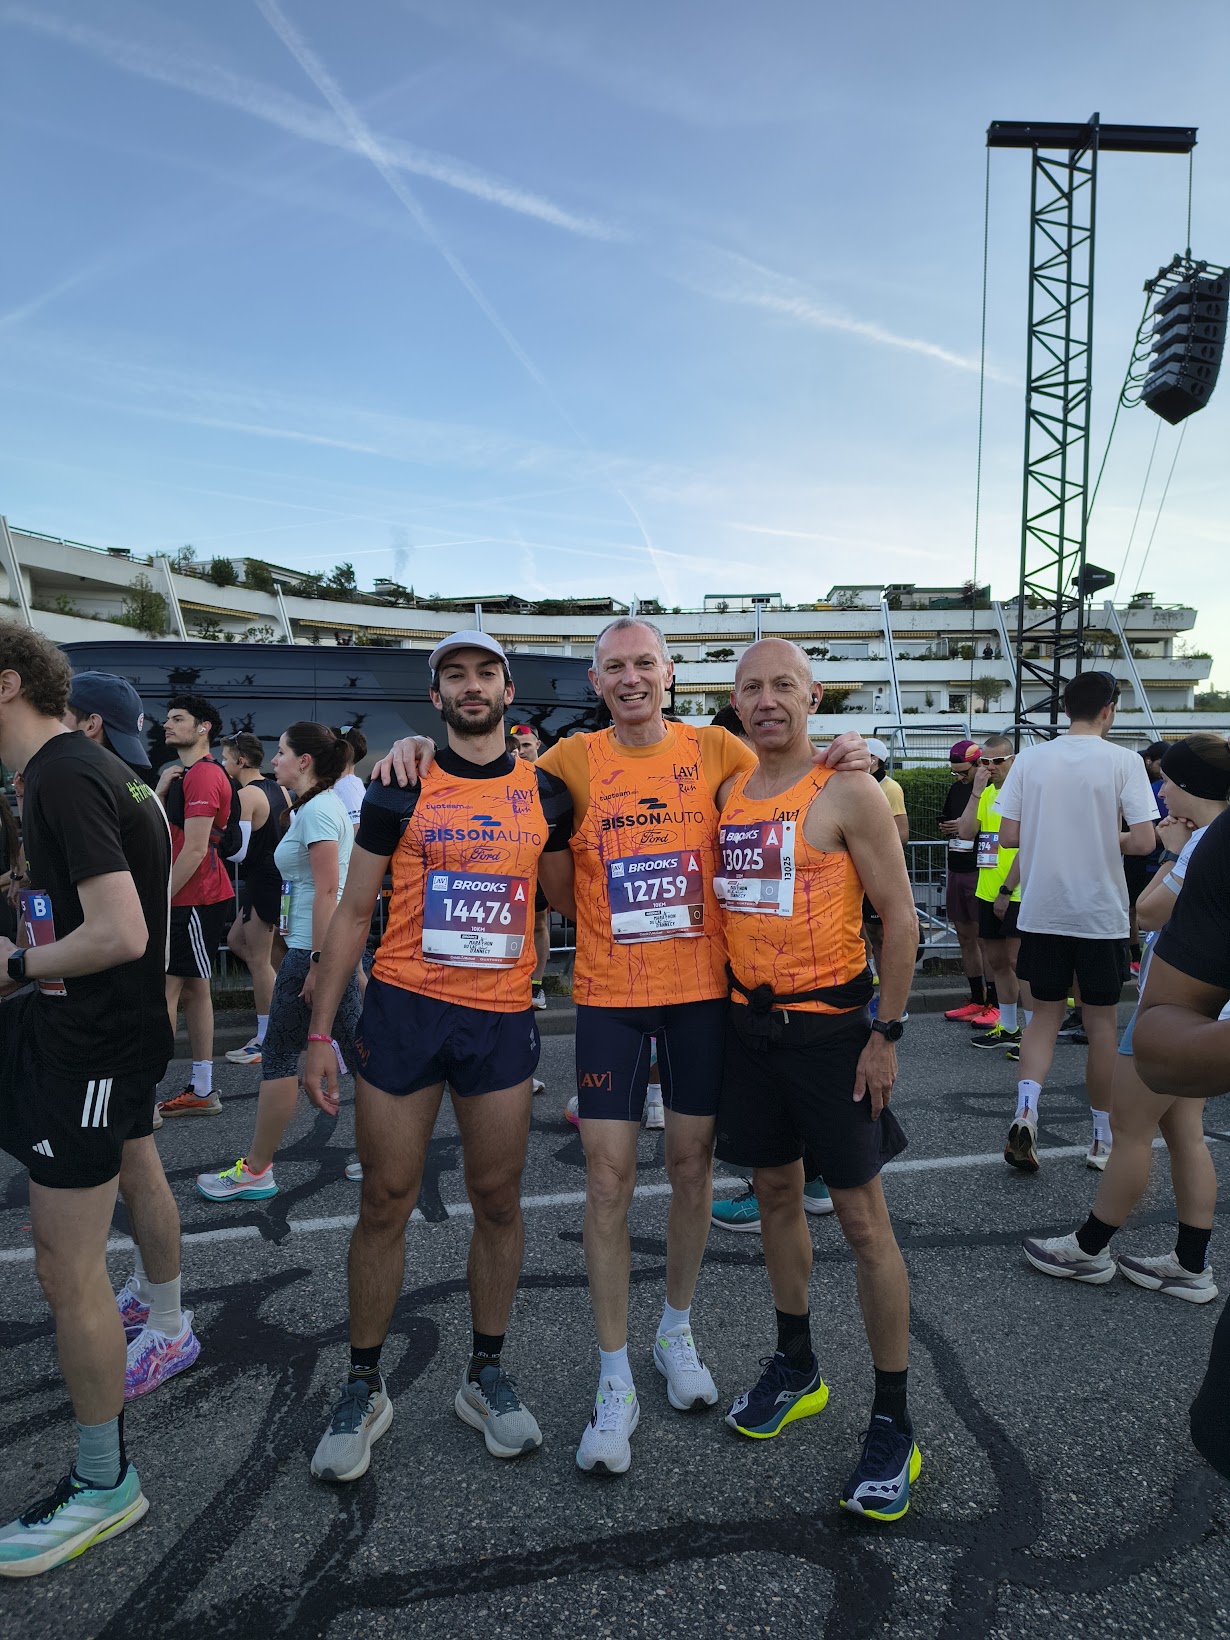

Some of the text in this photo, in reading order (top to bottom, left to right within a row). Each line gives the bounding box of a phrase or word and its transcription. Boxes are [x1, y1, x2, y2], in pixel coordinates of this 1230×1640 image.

[640, 831, 669, 844] Ford
[765, 827, 779, 846] A
[470, 846, 502, 861] Ford
[687, 854, 699, 872] A
[628, 858, 678, 874] BROOKS
[783, 856, 792, 881] 13025
[452, 880, 508, 893] BROOKS
[514, 883, 526, 902] A
[623, 875, 687, 903] 12759
[33, 898, 47, 917] B
[443, 898, 512, 925] 14476
